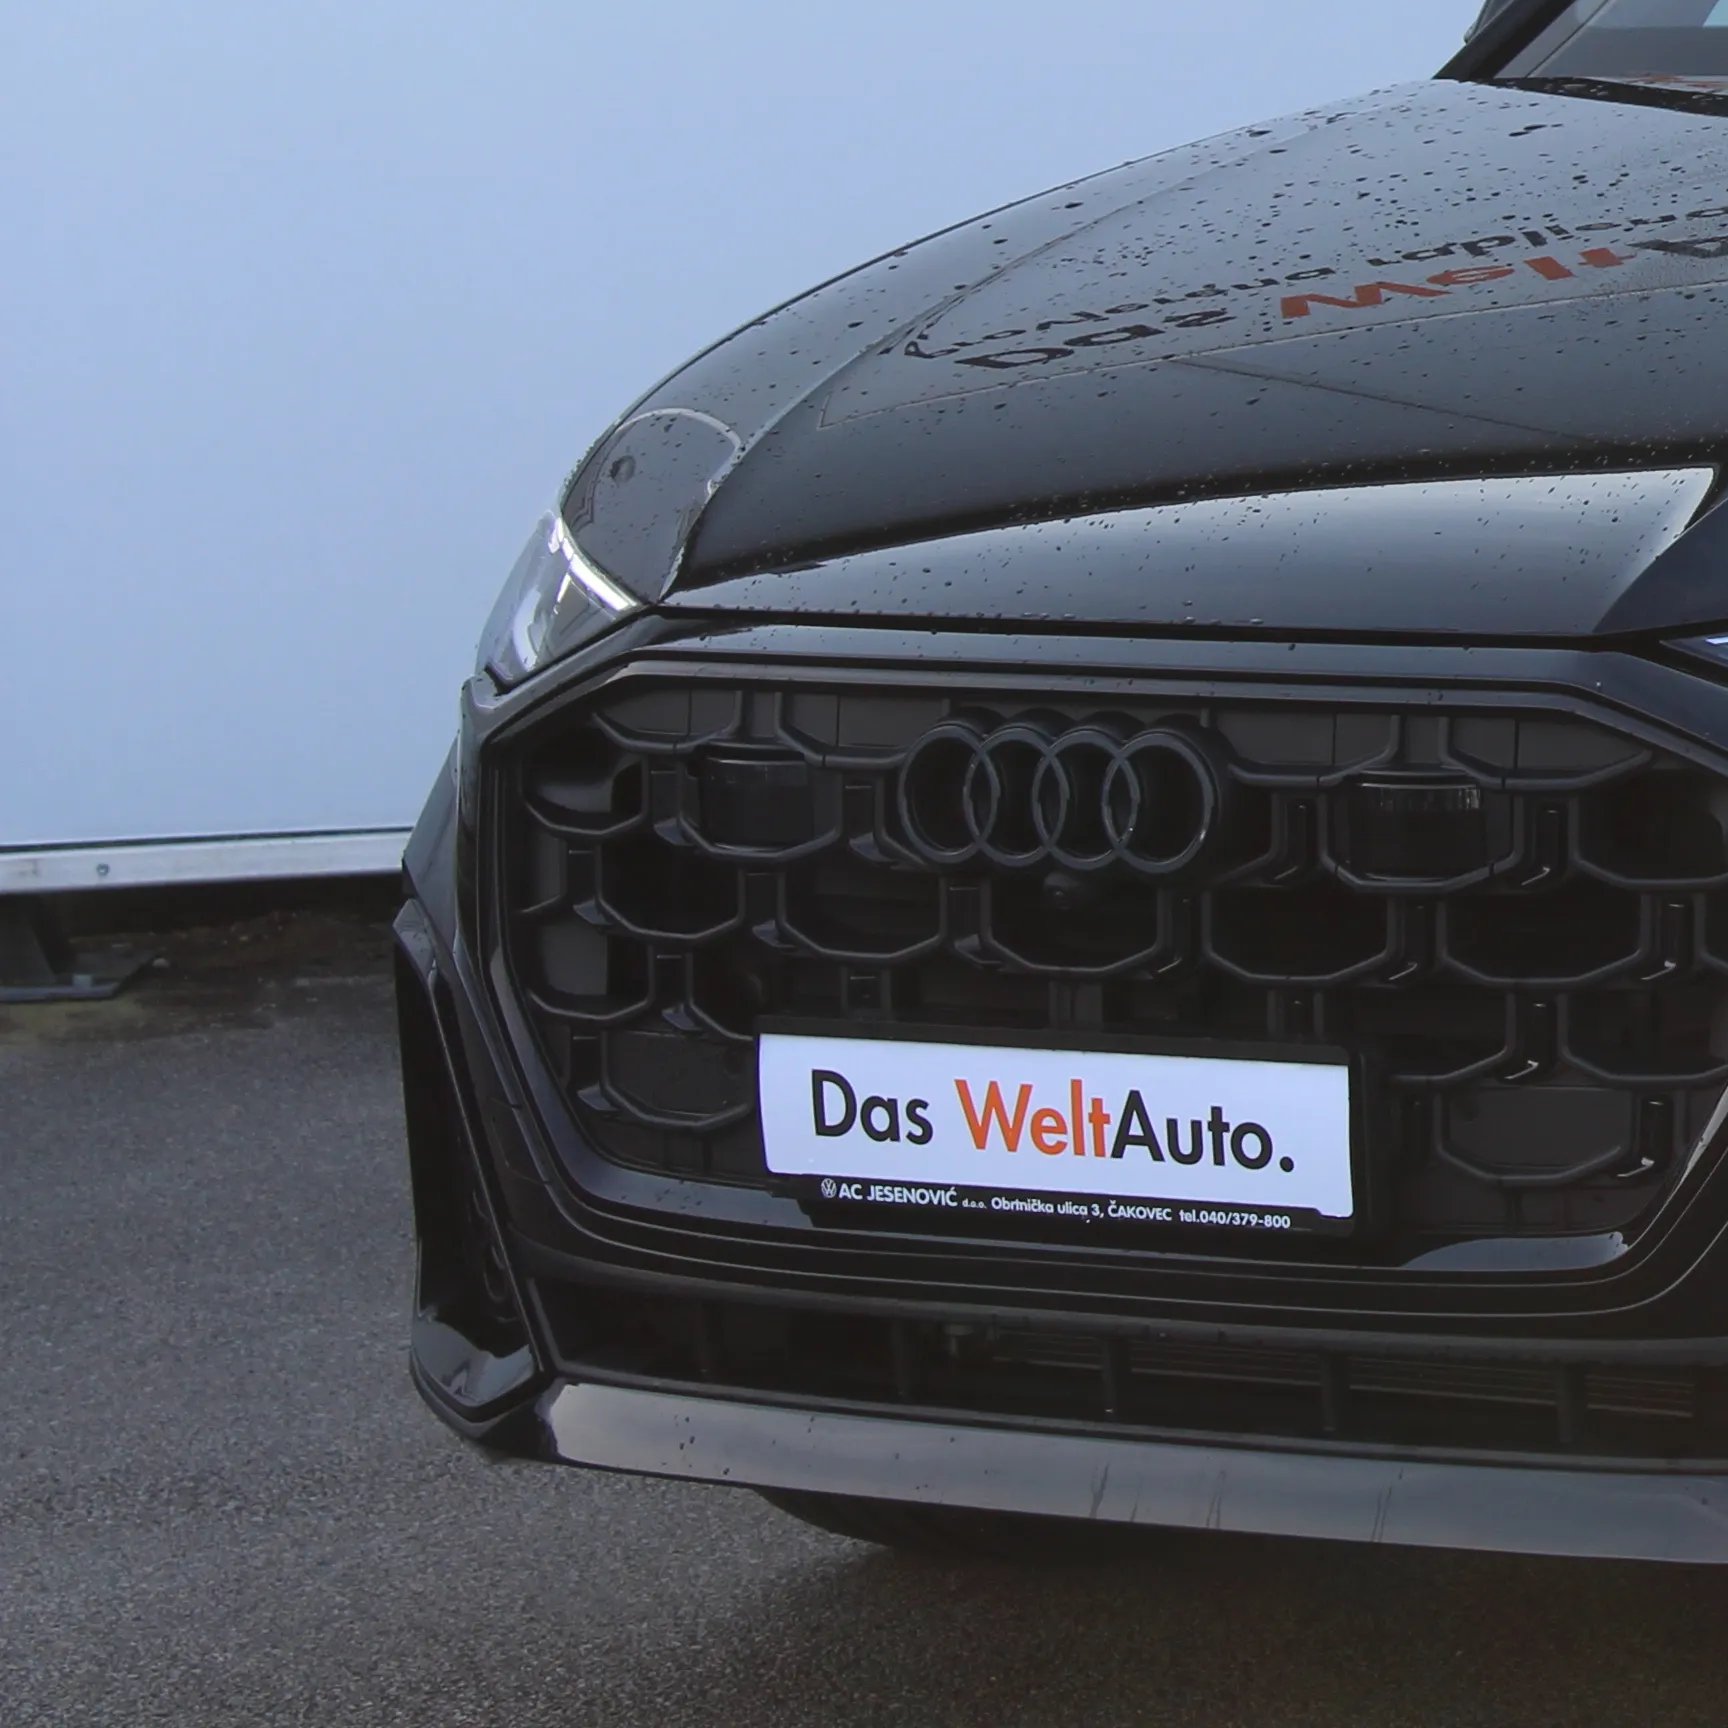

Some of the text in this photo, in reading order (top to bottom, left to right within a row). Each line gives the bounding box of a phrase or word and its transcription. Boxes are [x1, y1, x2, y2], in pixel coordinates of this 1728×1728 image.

[811, 1068, 1295, 1174] Das WeltAuto.
[838, 1182, 863, 1200] AC
[866, 1185, 958, 1207] JESENOVIĆ
[991, 1197, 1054, 1214] Obrtnička
[1057, 1201, 1088, 1216] ulica
[1107, 1200, 1172, 1221] ČAKOVEC
